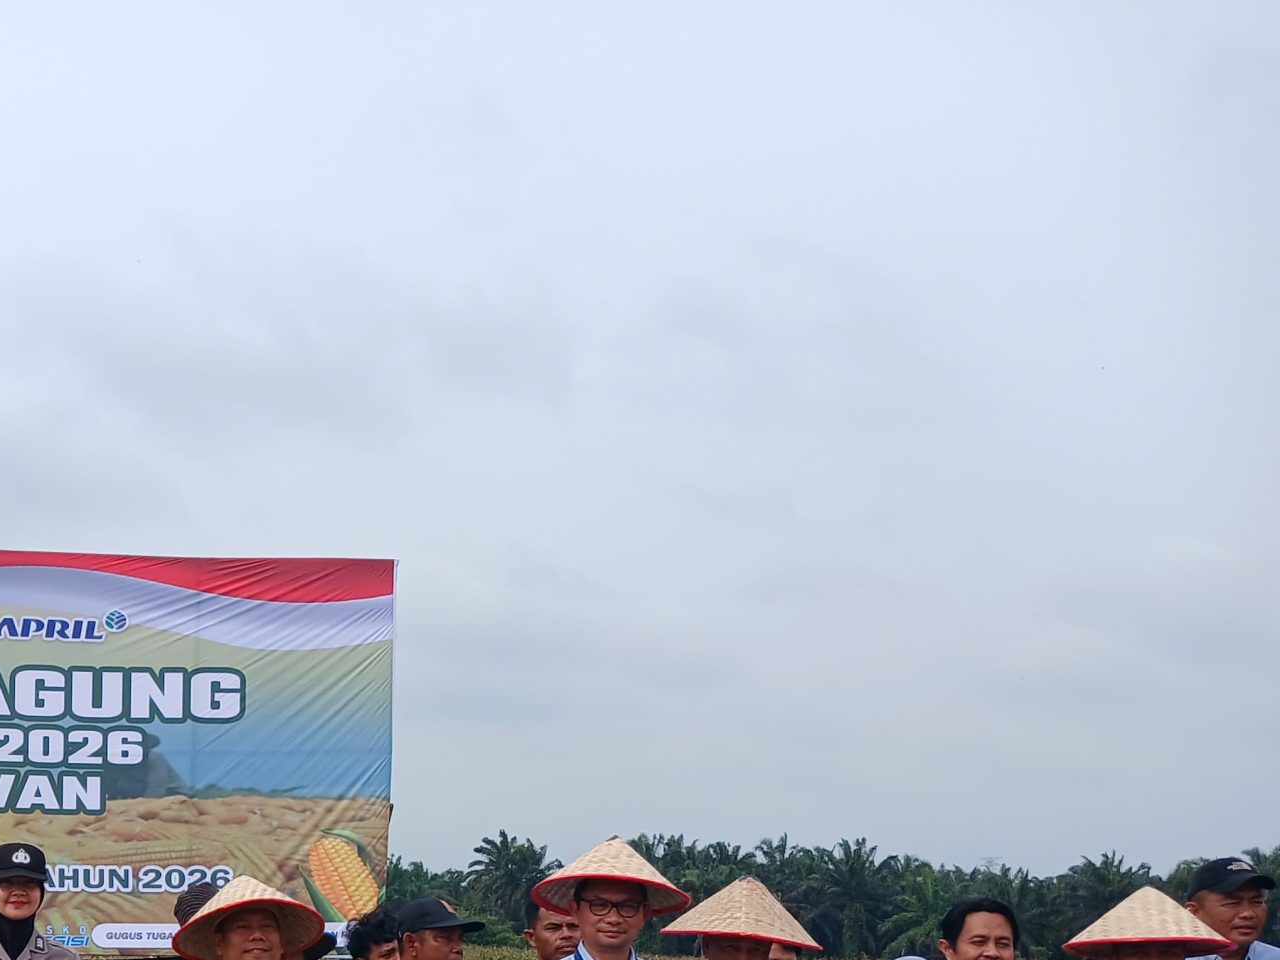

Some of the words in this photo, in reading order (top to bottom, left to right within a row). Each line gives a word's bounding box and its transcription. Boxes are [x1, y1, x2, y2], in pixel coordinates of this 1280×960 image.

[142, 868, 231, 890] 2026
[105, 931, 143, 940] GUGUS
[146, 931, 175, 940] TUGA
